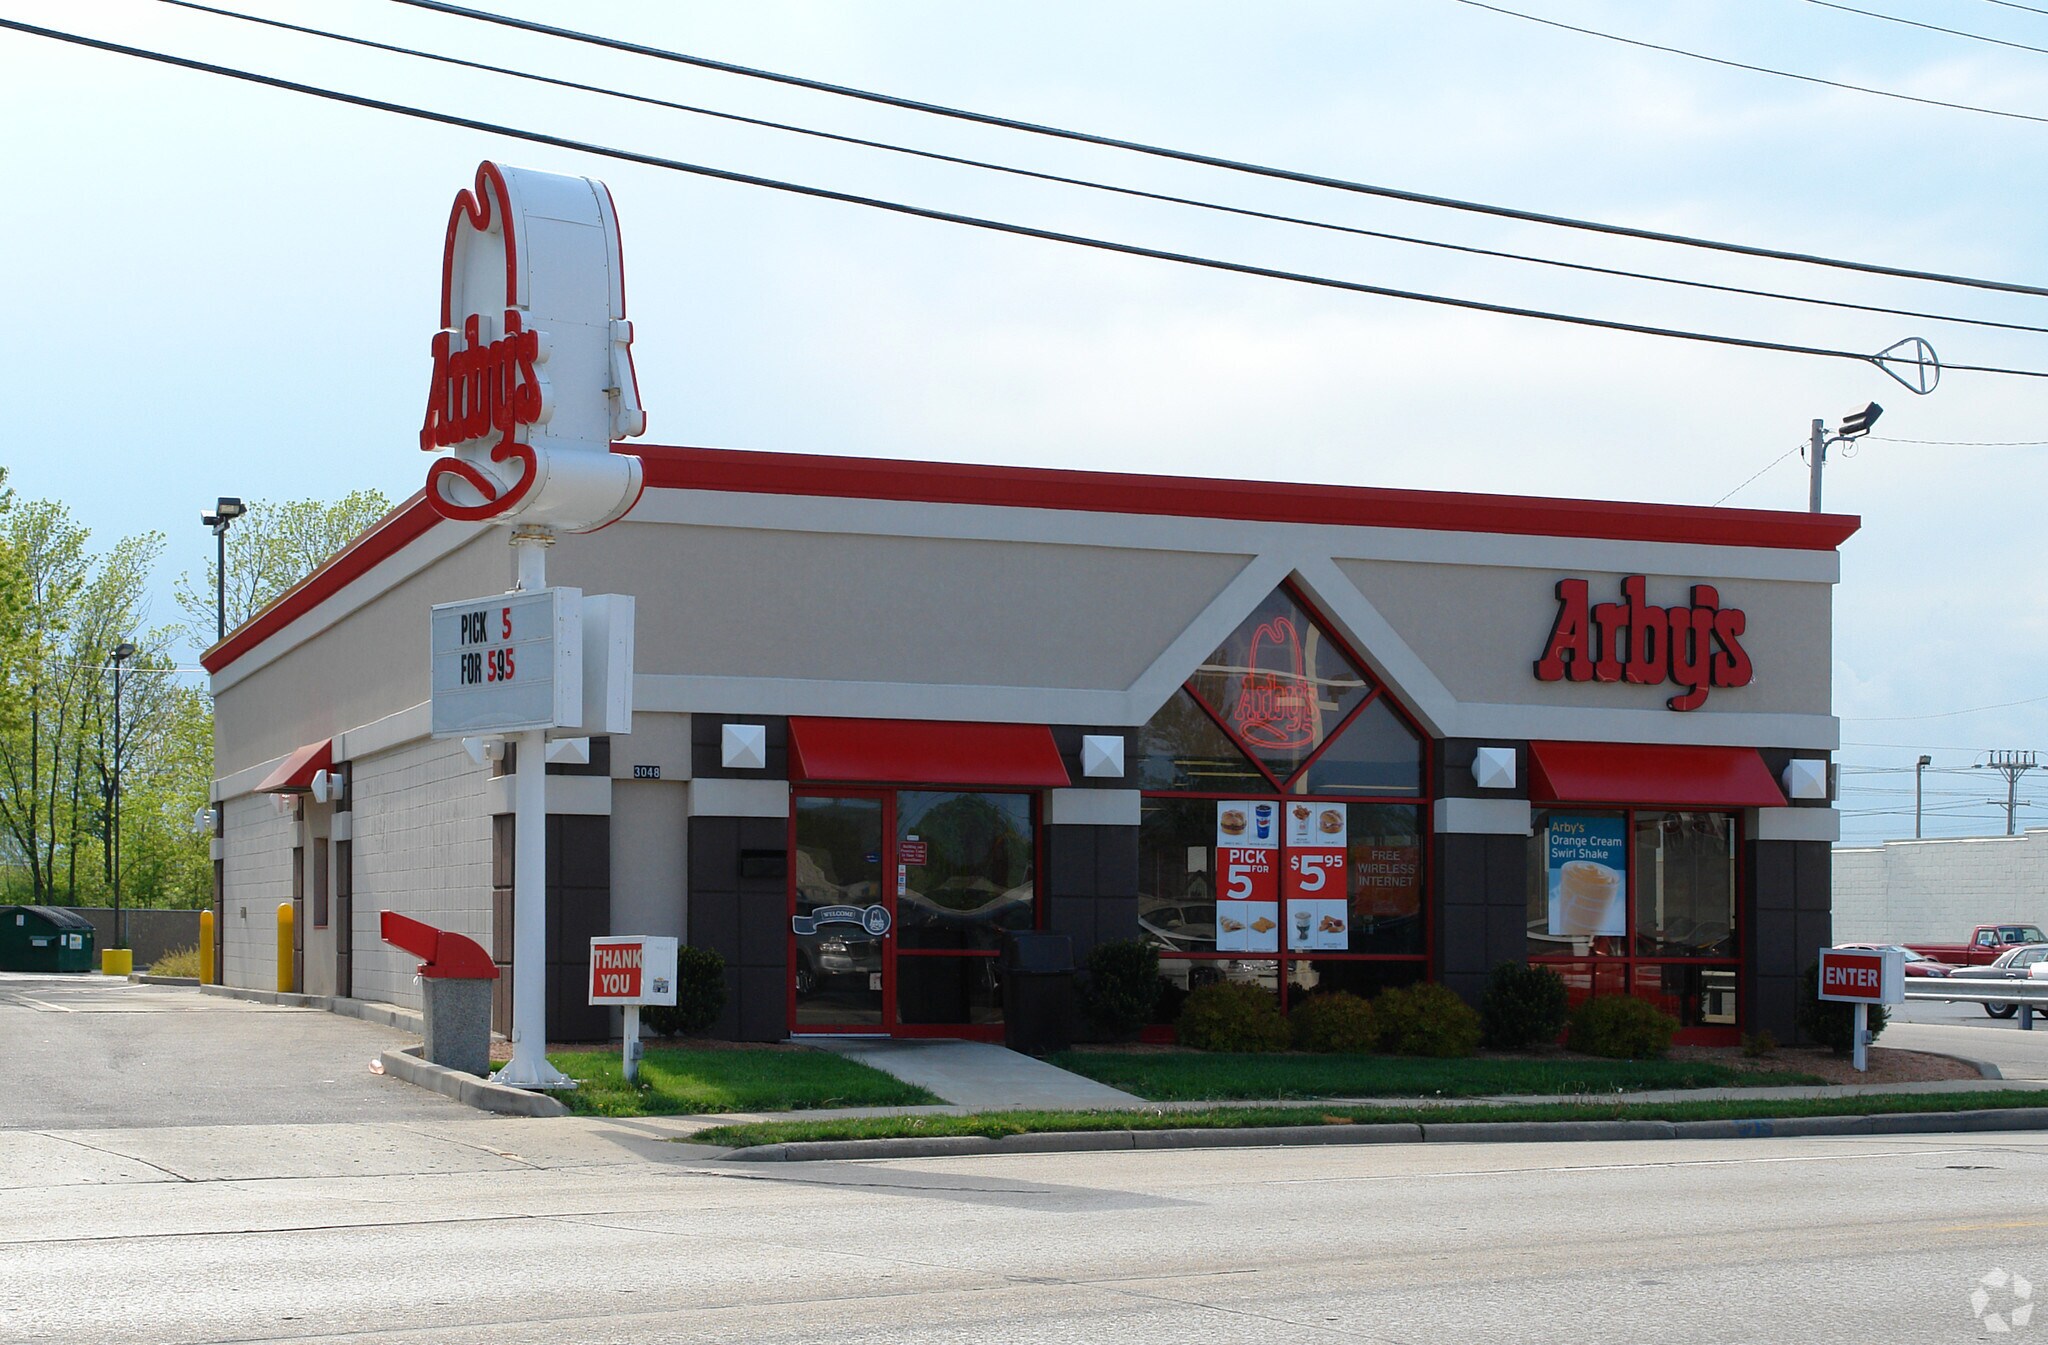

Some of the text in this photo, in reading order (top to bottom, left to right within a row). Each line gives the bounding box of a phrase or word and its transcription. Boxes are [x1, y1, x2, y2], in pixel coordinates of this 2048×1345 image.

[420, 309, 543, 463] Arby's
[461, 607, 512, 645] PICK 5
[1533, 575, 1753, 711] Arby's
[461, 648, 515, 685] FOR 595
[1234, 673, 1320, 731] Arby's
[634, 766, 660, 778] 3048
[1552, 822, 1585, 834] Arby's
[1551, 835, 1622, 847] Orange Cream
[1229, 849, 1267, 864] PICK
[1371, 850, 1401, 861] FREE
[1551, 848, 1608, 859] Swirl Shake
[1358, 863, 1416, 874] WIRELESS
[1226, 864, 1269, 900] 5 FOR
[1359, 876, 1414, 887] INTERNET
[823, 910, 854, 918] WELCOME
[594, 949, 642, 969] THANK
[601, 974, 630, 994] YOU
[1826, 966, 1878, 988] ENTER
